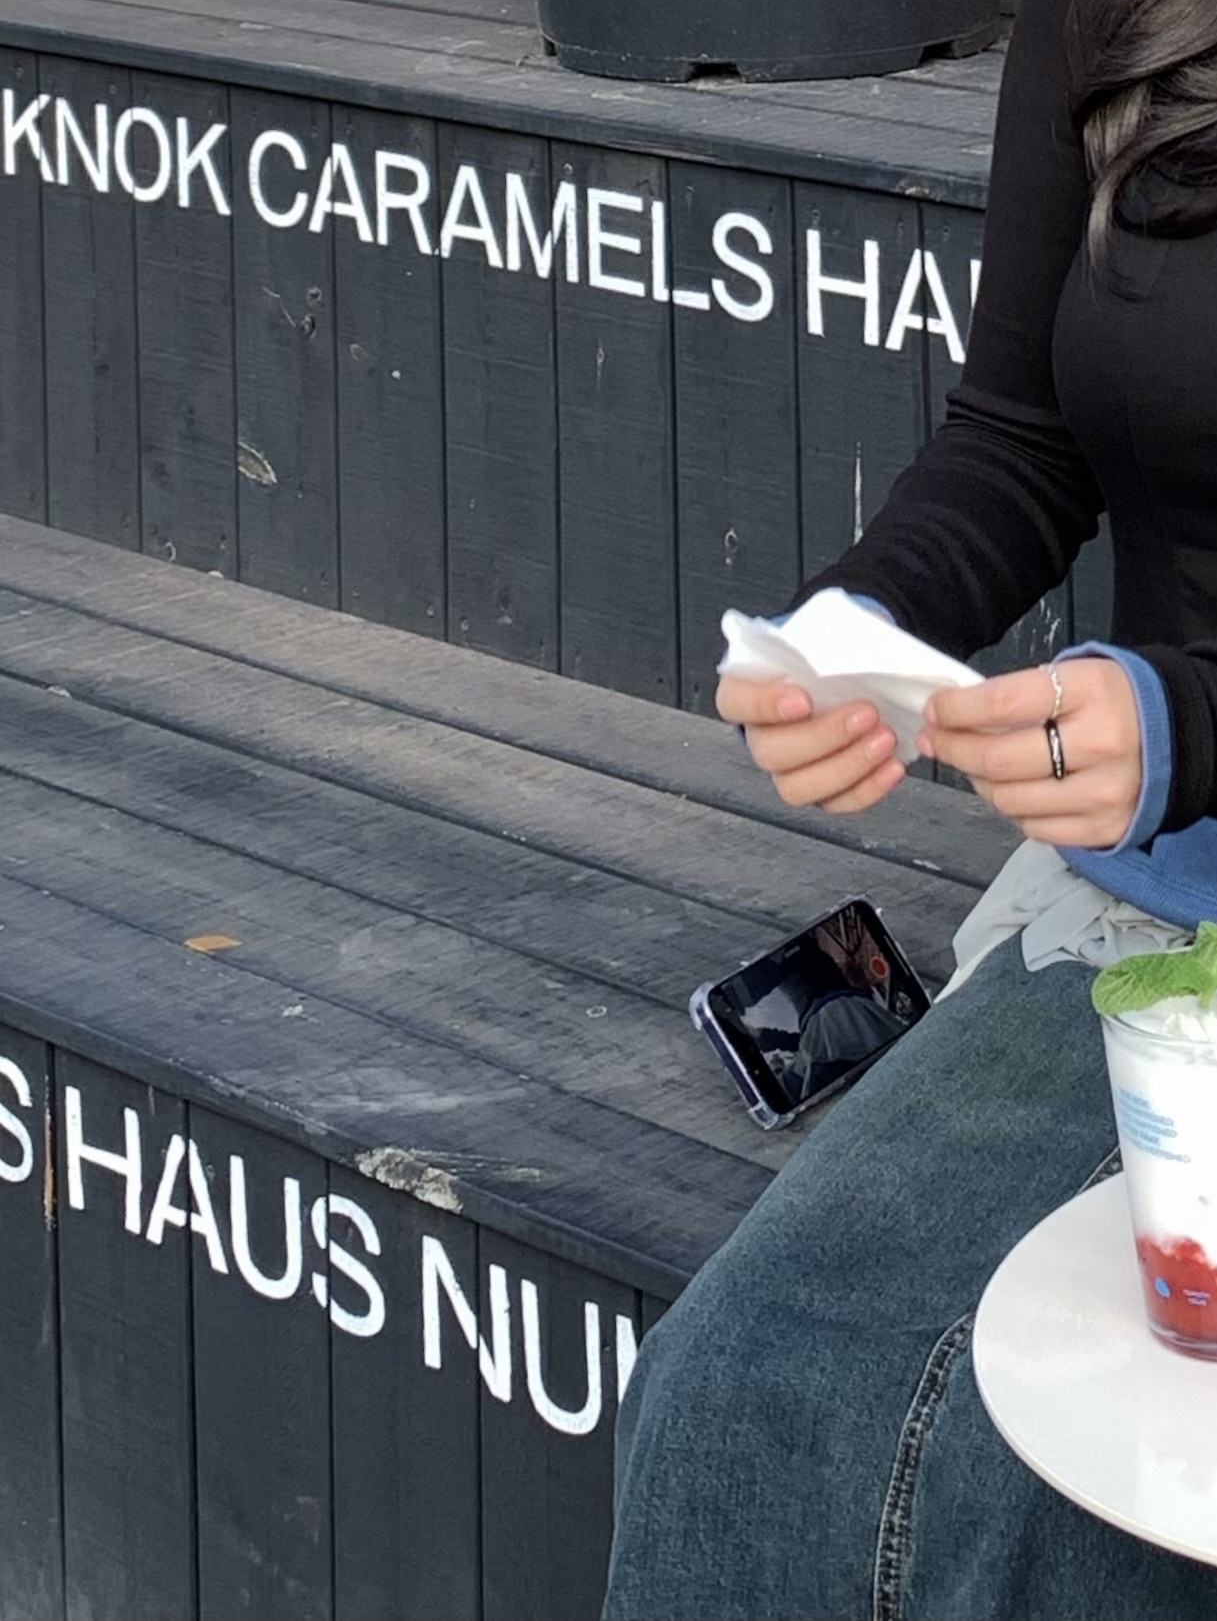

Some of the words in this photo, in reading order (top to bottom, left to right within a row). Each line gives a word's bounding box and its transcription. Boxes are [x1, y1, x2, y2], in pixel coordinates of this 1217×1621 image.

[2, 88, 231, 216] KNOK
[248, 129, 774, 322] CARAMELS
[806, 228, 982, 364] HA
[65, 1085, 386, 1337] HAUS
[422, 1235, 638, 1435] NU
